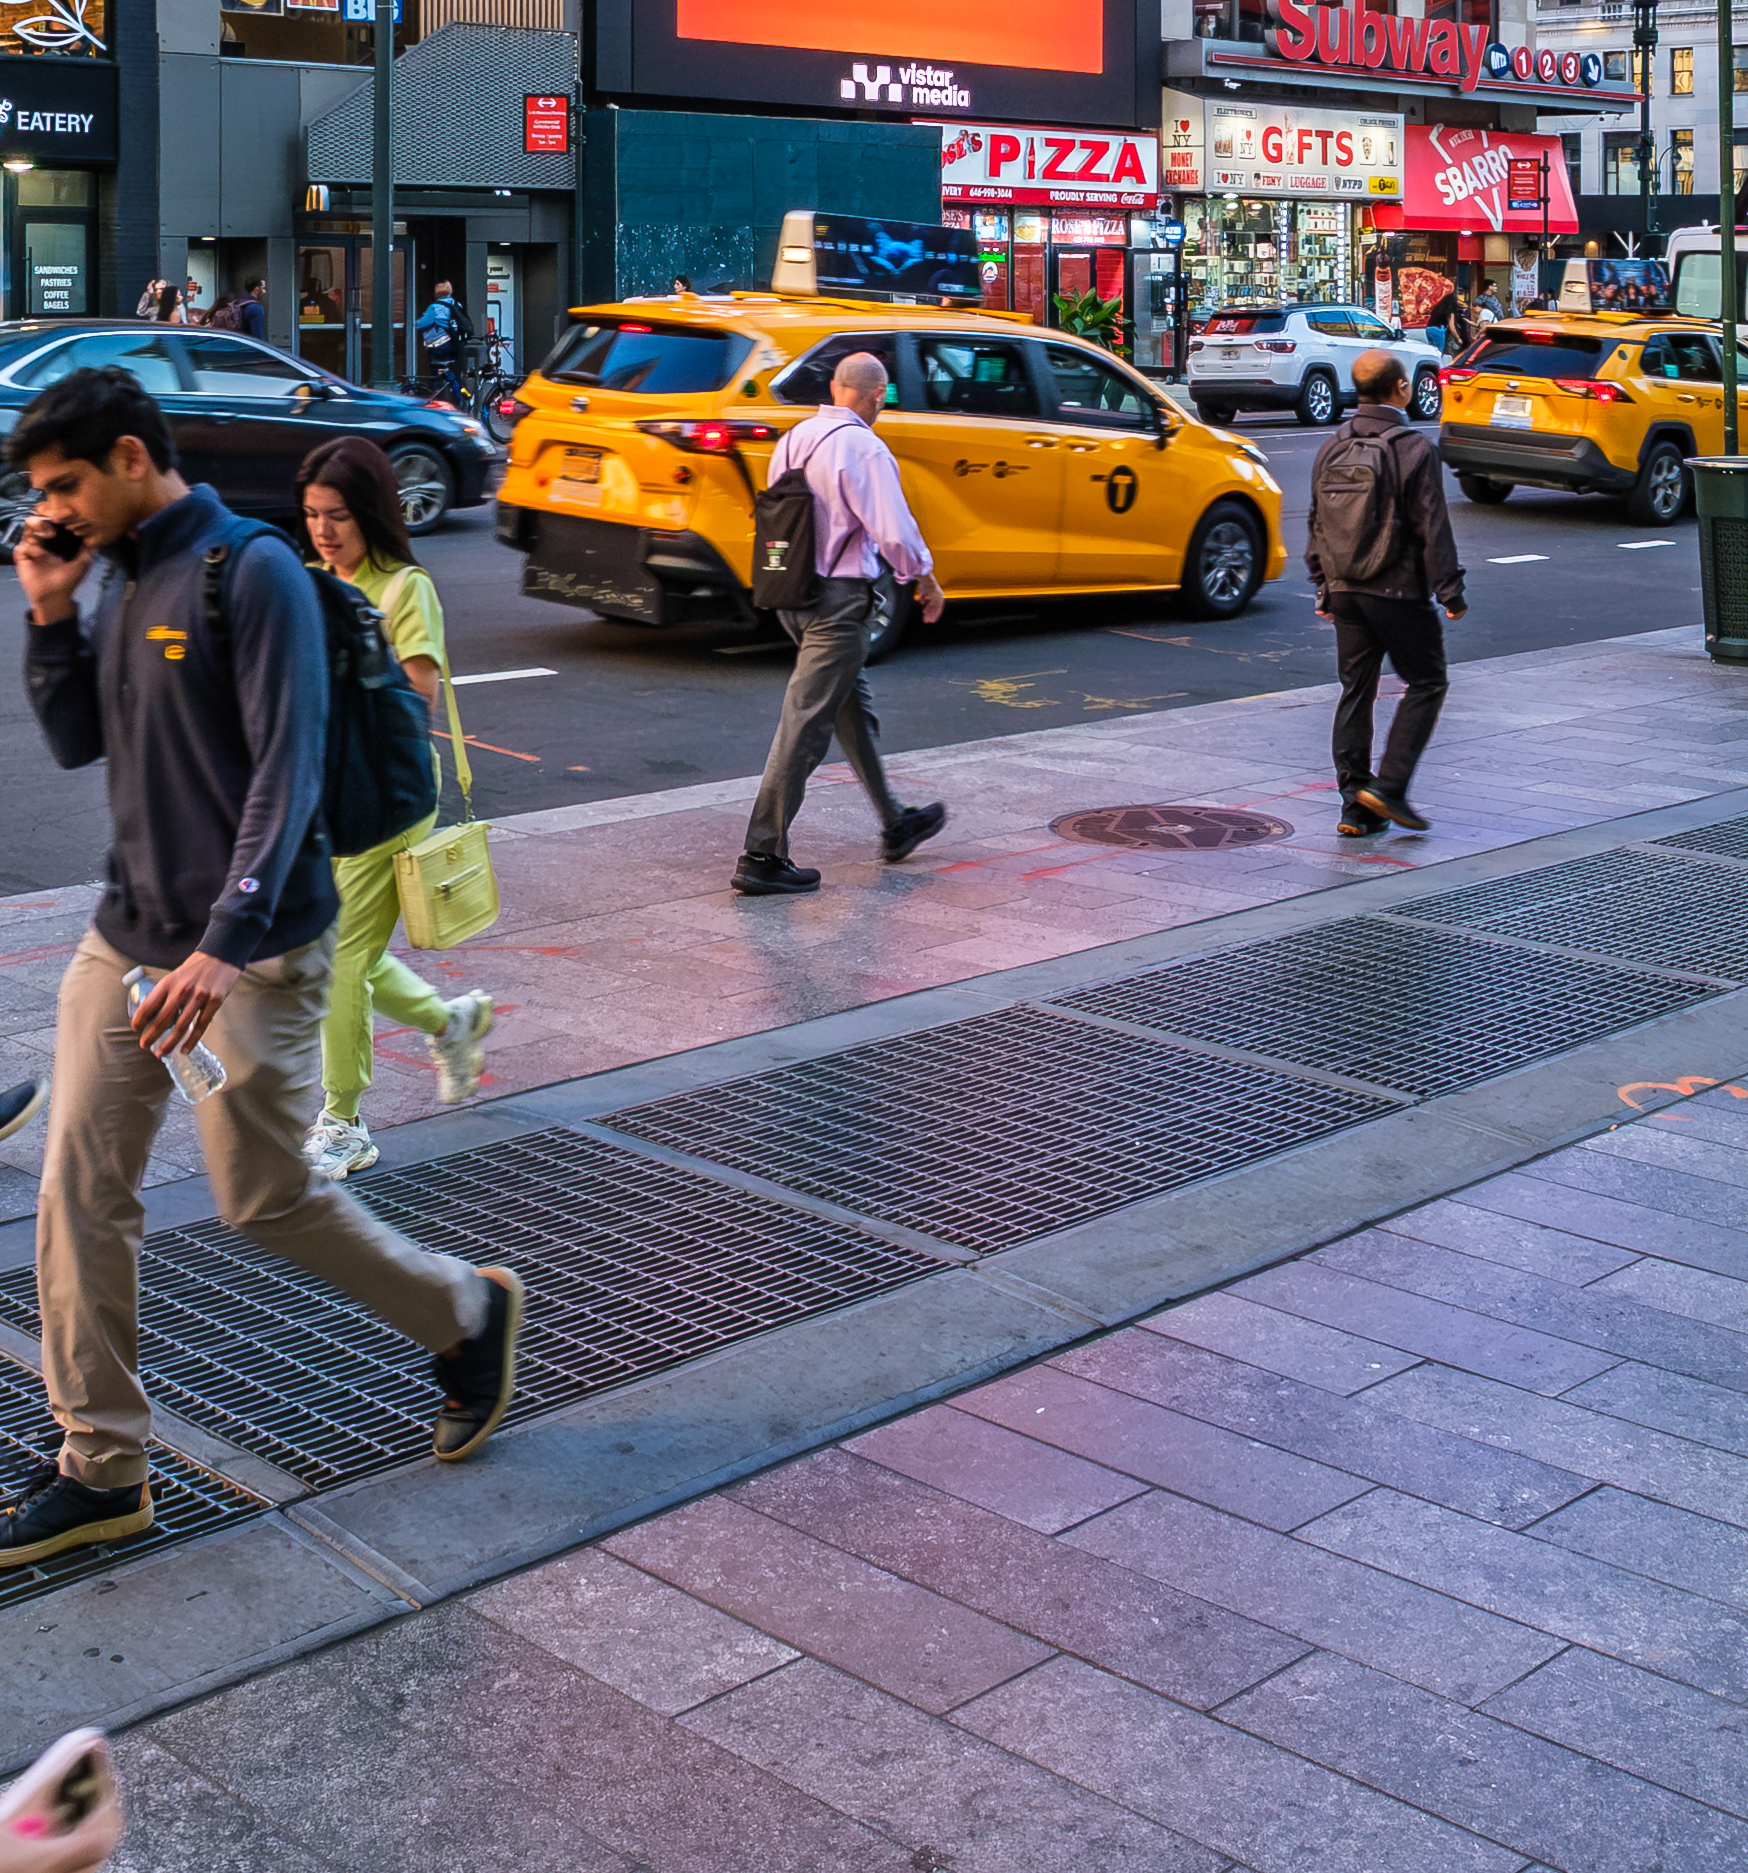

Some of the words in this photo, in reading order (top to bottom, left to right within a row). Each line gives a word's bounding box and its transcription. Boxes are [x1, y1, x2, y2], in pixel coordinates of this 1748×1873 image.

[1519, 51, 1527, 74] 1
[1542, 54, 1554, 77] 2
[1565, 56, 1576, 78] 3
[899, 62, 954, 87] vistar
[912, 83, 971, 108] media
[16, 110, 95, 134] EATERY
[1172, 134, 1192, 148] NY
[941, 129, 983, 169] SE'S
[1229, 173, 1245, 186] NY
[1289, 175, 1327, 190] LUGGAGE
[942, 185, 963, 197] IVERY
[1049, 190, 1085, 202] PROUDLY
[1085, 192, 1118, 204] SERVING
[33, 265, 79, 275] SANDWICHES
[40, 278, 73, 287] PASTRIES
[43, 291, 70, 300] COFFEE
[43, 301, 70, 310] BAGELS
